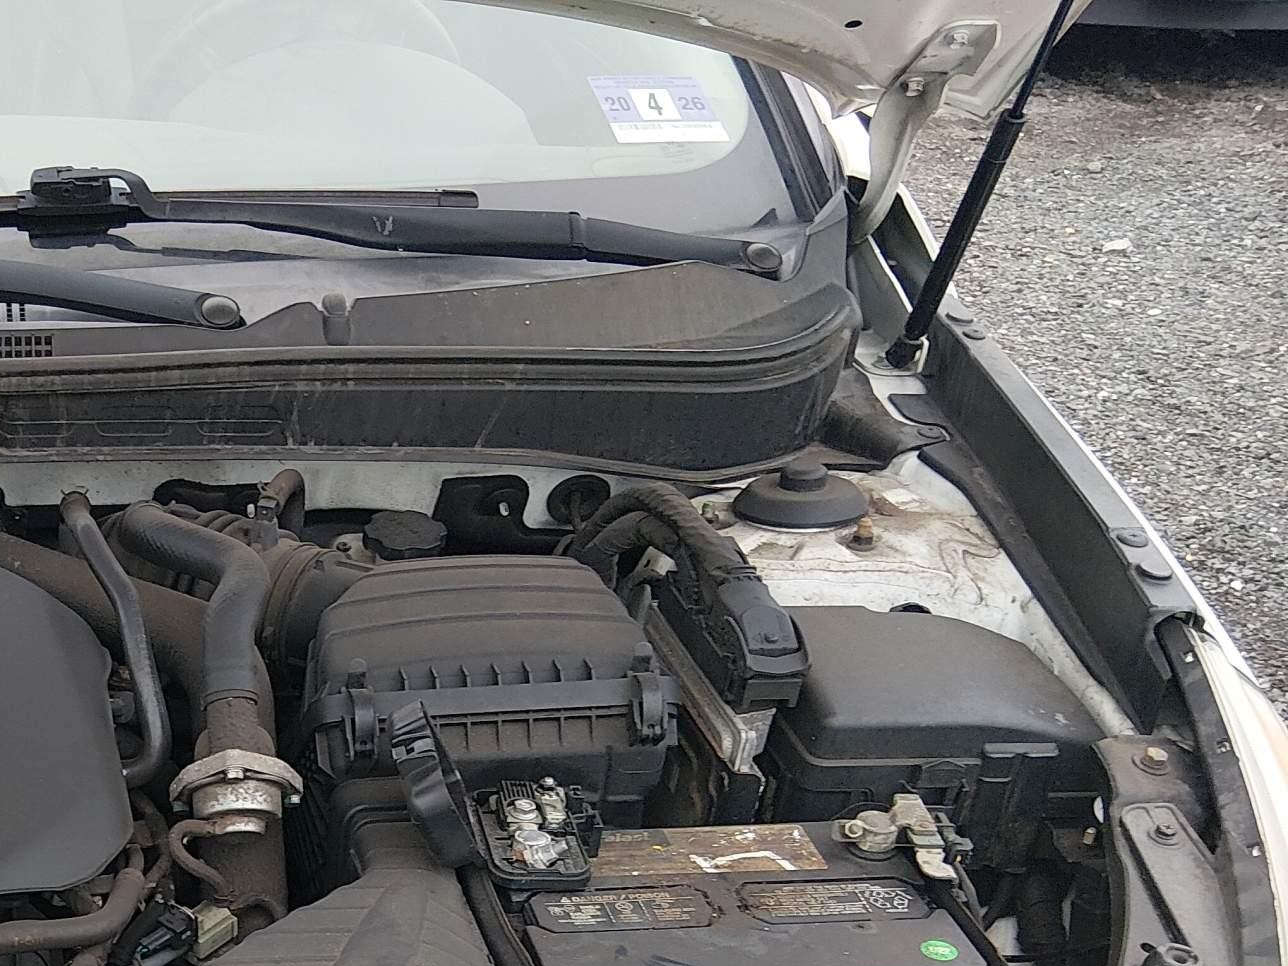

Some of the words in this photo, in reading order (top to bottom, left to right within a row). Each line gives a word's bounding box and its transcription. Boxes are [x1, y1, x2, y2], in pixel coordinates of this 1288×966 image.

[604, 96, 631, 112] 20
[647, 92, 663, 116] 4
[677, 96, 706, 111] 26
